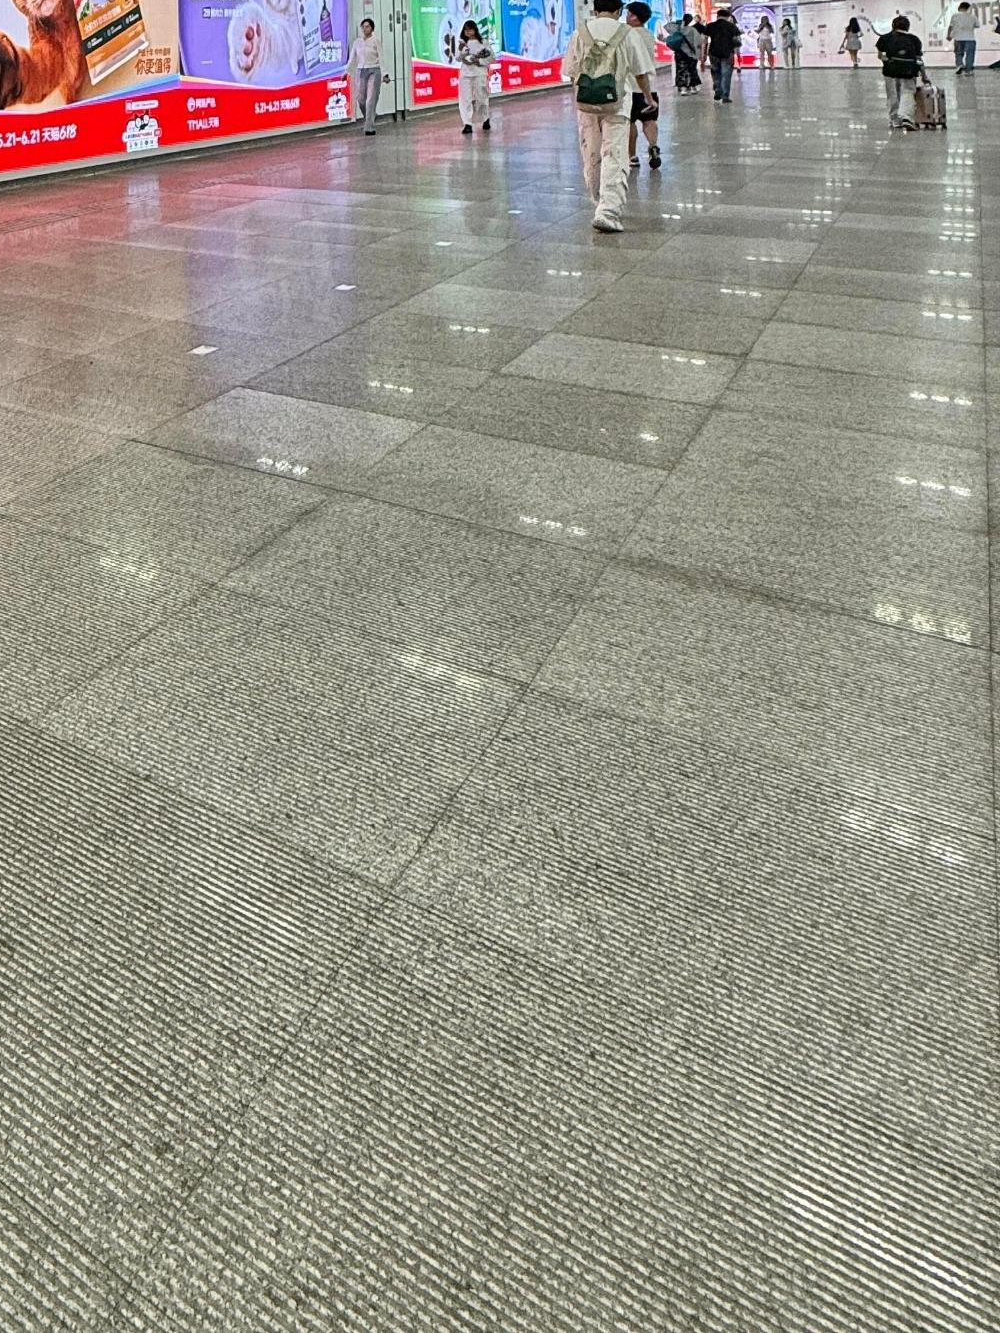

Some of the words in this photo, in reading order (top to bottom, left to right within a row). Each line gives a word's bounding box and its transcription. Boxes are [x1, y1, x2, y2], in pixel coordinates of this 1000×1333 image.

[134, 57, 171, 75] 你更值得
[41, 123, 77, 143] 天猫618
